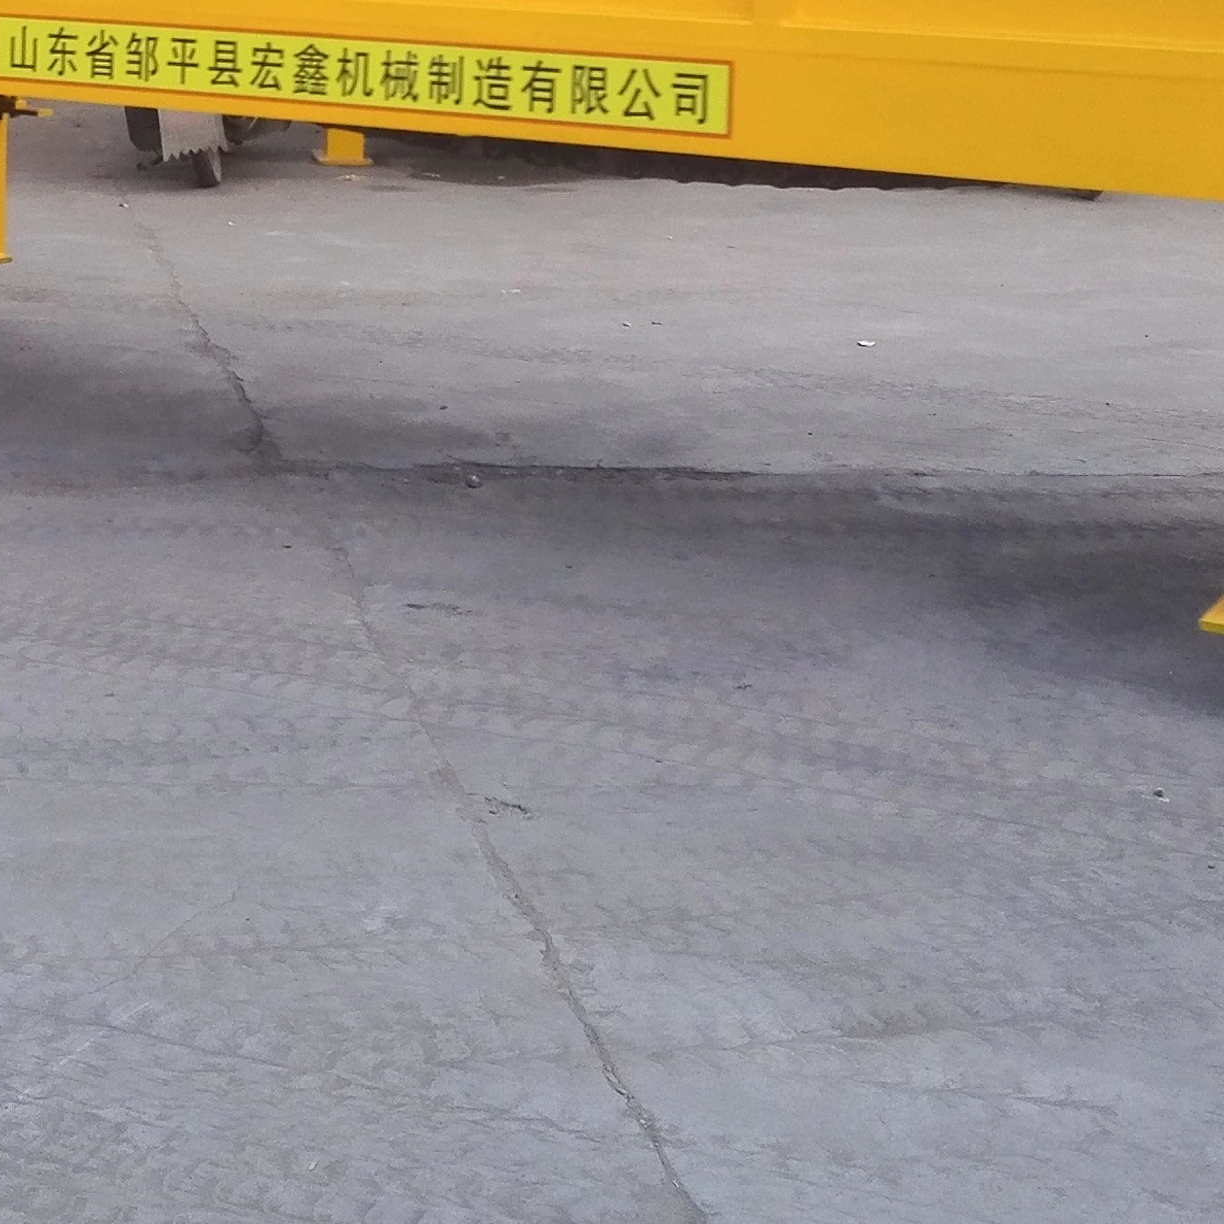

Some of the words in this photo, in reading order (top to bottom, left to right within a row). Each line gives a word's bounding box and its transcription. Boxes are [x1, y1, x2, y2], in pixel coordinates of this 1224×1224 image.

[8, 25, 711, 125] 山东省邹平县宏鑫机械制造有限公司
